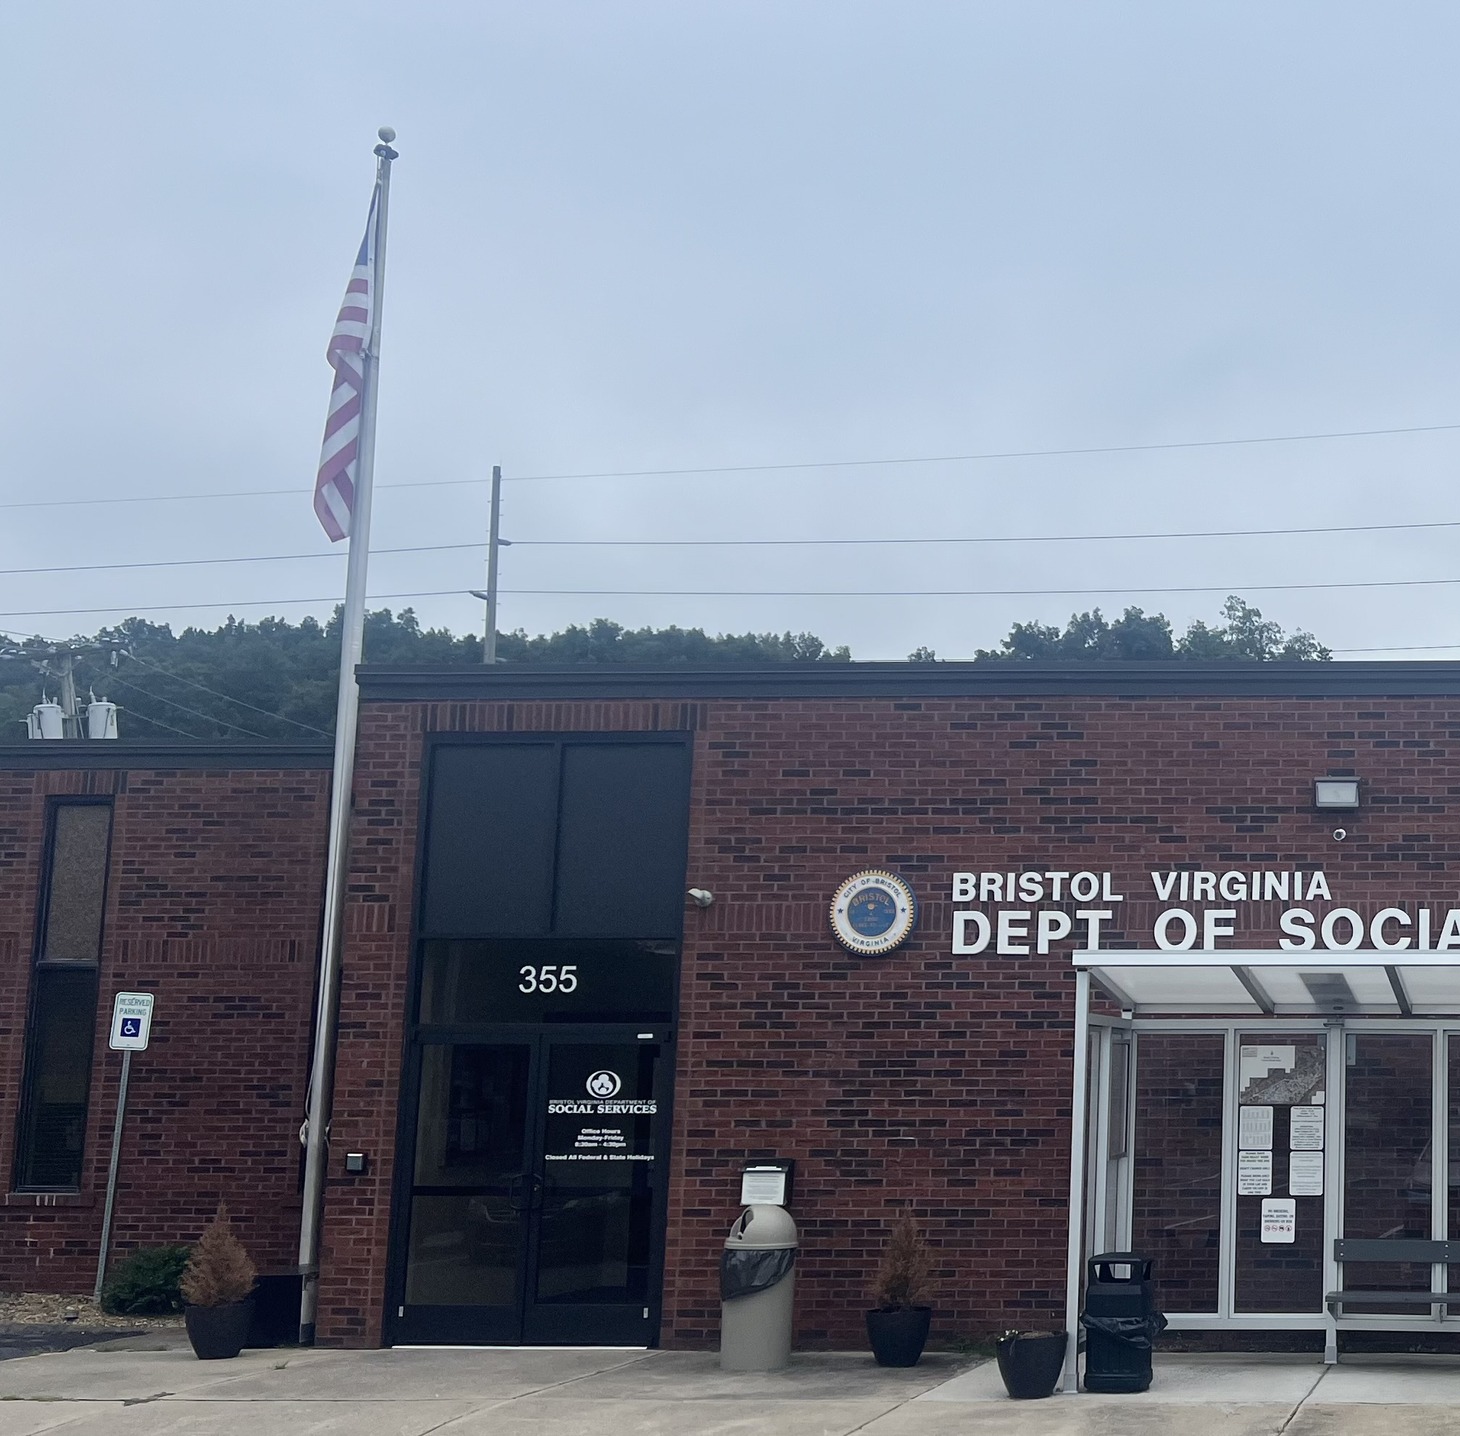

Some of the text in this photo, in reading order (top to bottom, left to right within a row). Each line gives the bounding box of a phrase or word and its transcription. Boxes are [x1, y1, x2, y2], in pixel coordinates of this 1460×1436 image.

[843, 878, 902, 898] CITY OF BRISTOL
[952, 871, 1333, 902] BRISTOL VIRGINIA
[951, 909, 1113, 954] DEPT
[1153, 908, 1237, 950] OF
[852, 936, 889, 947] VIRGINIA
[518, 965, 578, 993] 355
[120, 998, 150, 1006] RESERVED
[120, 1008, 147, 1016] PARKING
[548, 1104, 657, 1114] SOCIAL SERVICES
